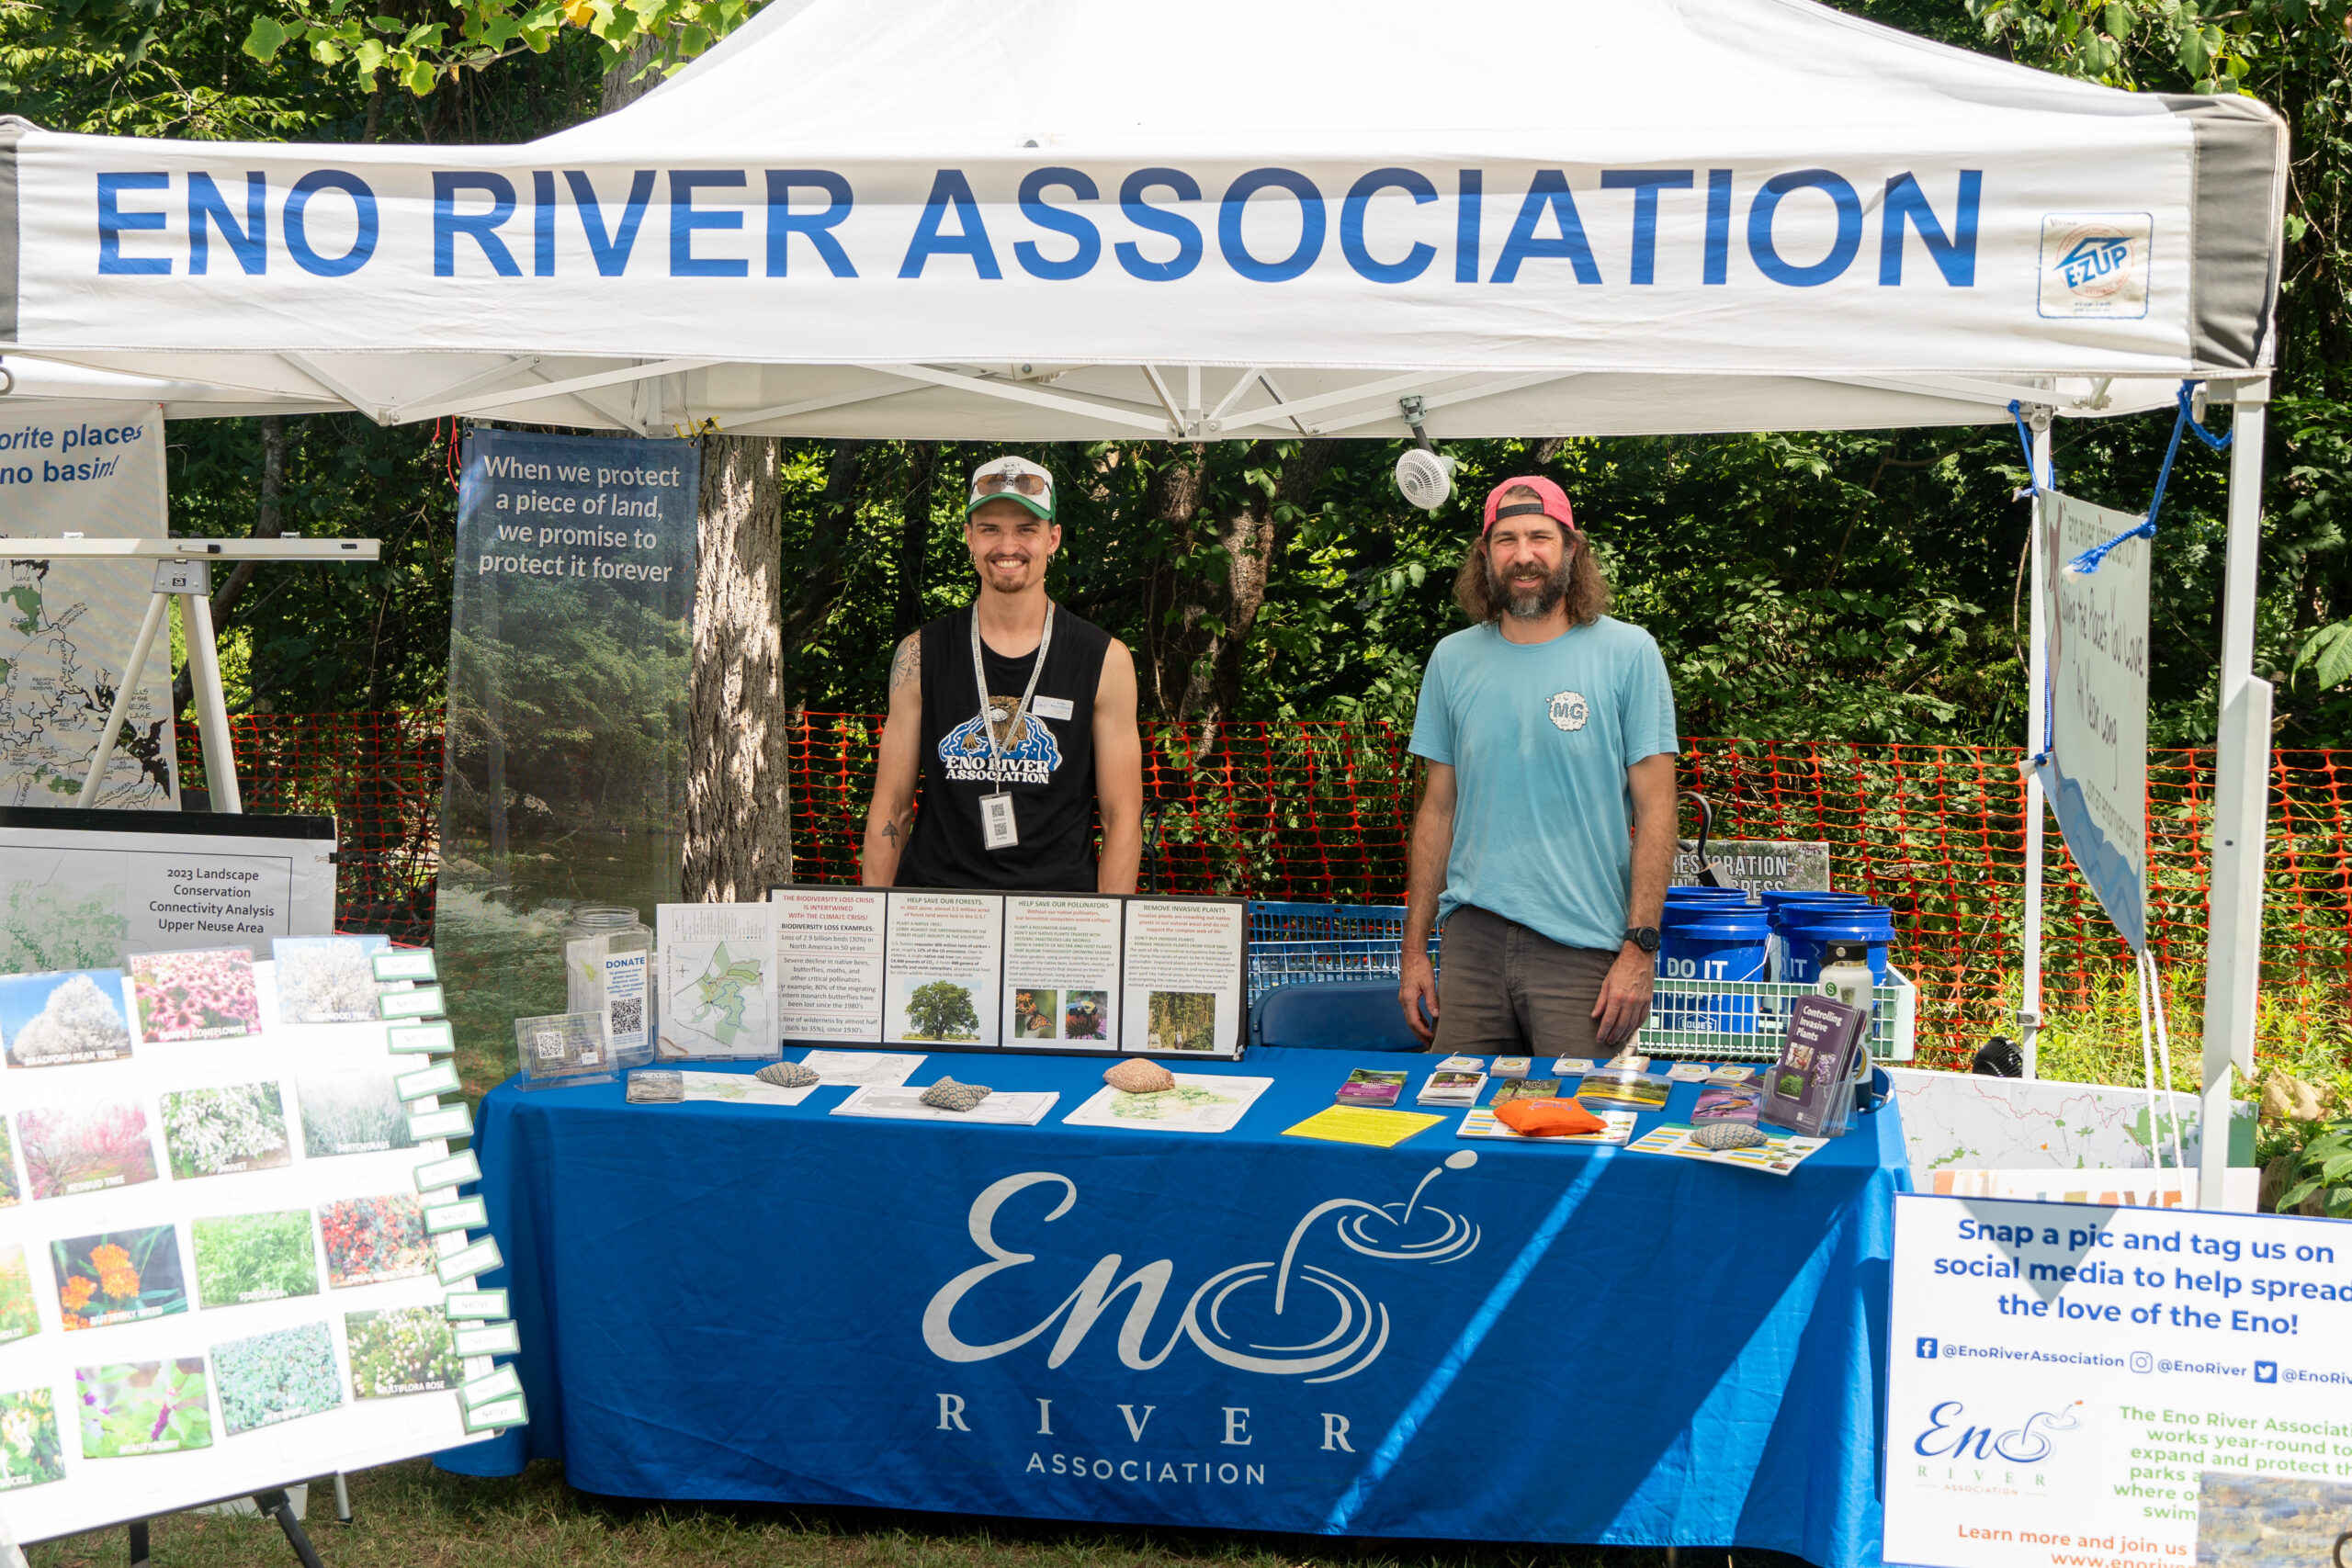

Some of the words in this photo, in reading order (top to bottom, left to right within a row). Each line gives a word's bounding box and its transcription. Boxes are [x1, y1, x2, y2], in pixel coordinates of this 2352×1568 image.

[96, 169, 379, 277] ENO
[432, 168, 859, 278] RIVER
[897, 165, 1984, 288] ASSOCIATION
[62, 423, 143, 453] places
[44, 455, 119, 482] basin!
[483, 455, 551, 481] When
[558, 466, 591, 483] we
[598, 466, 680, 488] protect
[496, 494, 509, 510] a
[515, 490, 575, 514] piece
[582, 494, 606, 515] of
[611, 495, 663, 522] land,
[498, 525, 532, 542] we
[539, 525, 628, 547] promise
[634, 528, 657, 549] to
[479, 553, 564, 575] protect
[571, 555, 585, 577] it
[593, 557, 673, 582] forever
[1554, 703, 1583, 719] MG
[945, 755, 986, 770] ENO
[988, 757, 1049, 773] RIVER
[945, 769, 1049, 784] ASSOCIATION
[167, 869, 193, 880] 2023
[197, 868, 259, 883] Landscape
[174, 885, 251, 897] Conservation
[149, 901, 223, 917] Connectivity
[225, 904, 275, 919] Analysis
[158, 919, 195, 932] Upper
[198, 920, 233, 931] Neuse
[237, 922, 264, 933] Area
[605, 957, 645, 969] DONATE
[1667, 957, 1696, 978] DO
[1704, 960, 1728, 980] IT
[1799, 1017, 1828, 1032] Invasive
[1803, 1005, 1843, 1028] Controlling
[1796, 1027, 1818, 1042] Plants
[1958, 1218, 2034, 1249] Snap
[2041, 1227, 2059, 1247] a
[2068, 1223, 2114, 1251] pic
[2123, 1229, 2181, 1253] and
[2190, 1235, 2242, 1262] tag
[2251, 1241, 2287, 1261] us
[2295, 1243, 2334, 1264] on
[922, 1171, 1390, 1383] Eno
[1934, 1254, 2019, 1280] social
[2029, 1259, 2124, 1286] media
[2132, 1266, 2165, 1289] to
[2175, 1268, 2243, 1296] help
[2250, 1274, 2352, 1303] spread
[1997, 1292, 2049, 1318] the
[2057, 1297, 2121, 1323] love
[2131, 1303, 2162, 1325] of
[2169, 1305, 2222, 1329] the
[2231, 1309, 2299, 1336] Eno!
[1942, 1342, 2124, 1369] @EnoRiverAssociation
[2157, 1357, 2247, 1378] @EnoRiver
[425, 1380, 446, 1390] ROSE
[935, 1393, 1356, 1453] RIVER
[2120, 1405, 2155, 1421] The
[2163, 1409, 2199, 1425] Eno
[2206, 1413, 2257, 1429] River
[1914, 1400, 2055, 1463] Eno
[2147, 1429, 2209, 1445] works
[2215, 1434, 2325, 1455] year-round
[2333, 1443, 2352, 1457] to
[1026, 1451, 1265, 1484] ASSOCIATION
[2130, 1448, 2205, 1464] expand
[2211, 1454, 2248, 1468] and
[2256, 1457, 2329, 1472] protect
[1917, 1465, 2045, 1486] RIVER
[2130, 1466, 2186, 1482] parks
[2114, 1483, 2177, 1500] where
[2143, 1505, 2196, 1520] swim
[1958, 1524, 2013, 1541] Learn
[2020, 1530, 2071, 1546] more
[2077, 1536, 2115, 1550] and
[2120, 1537, 2158, 1554] join
[2165, 1544, 2188, 1556] us
